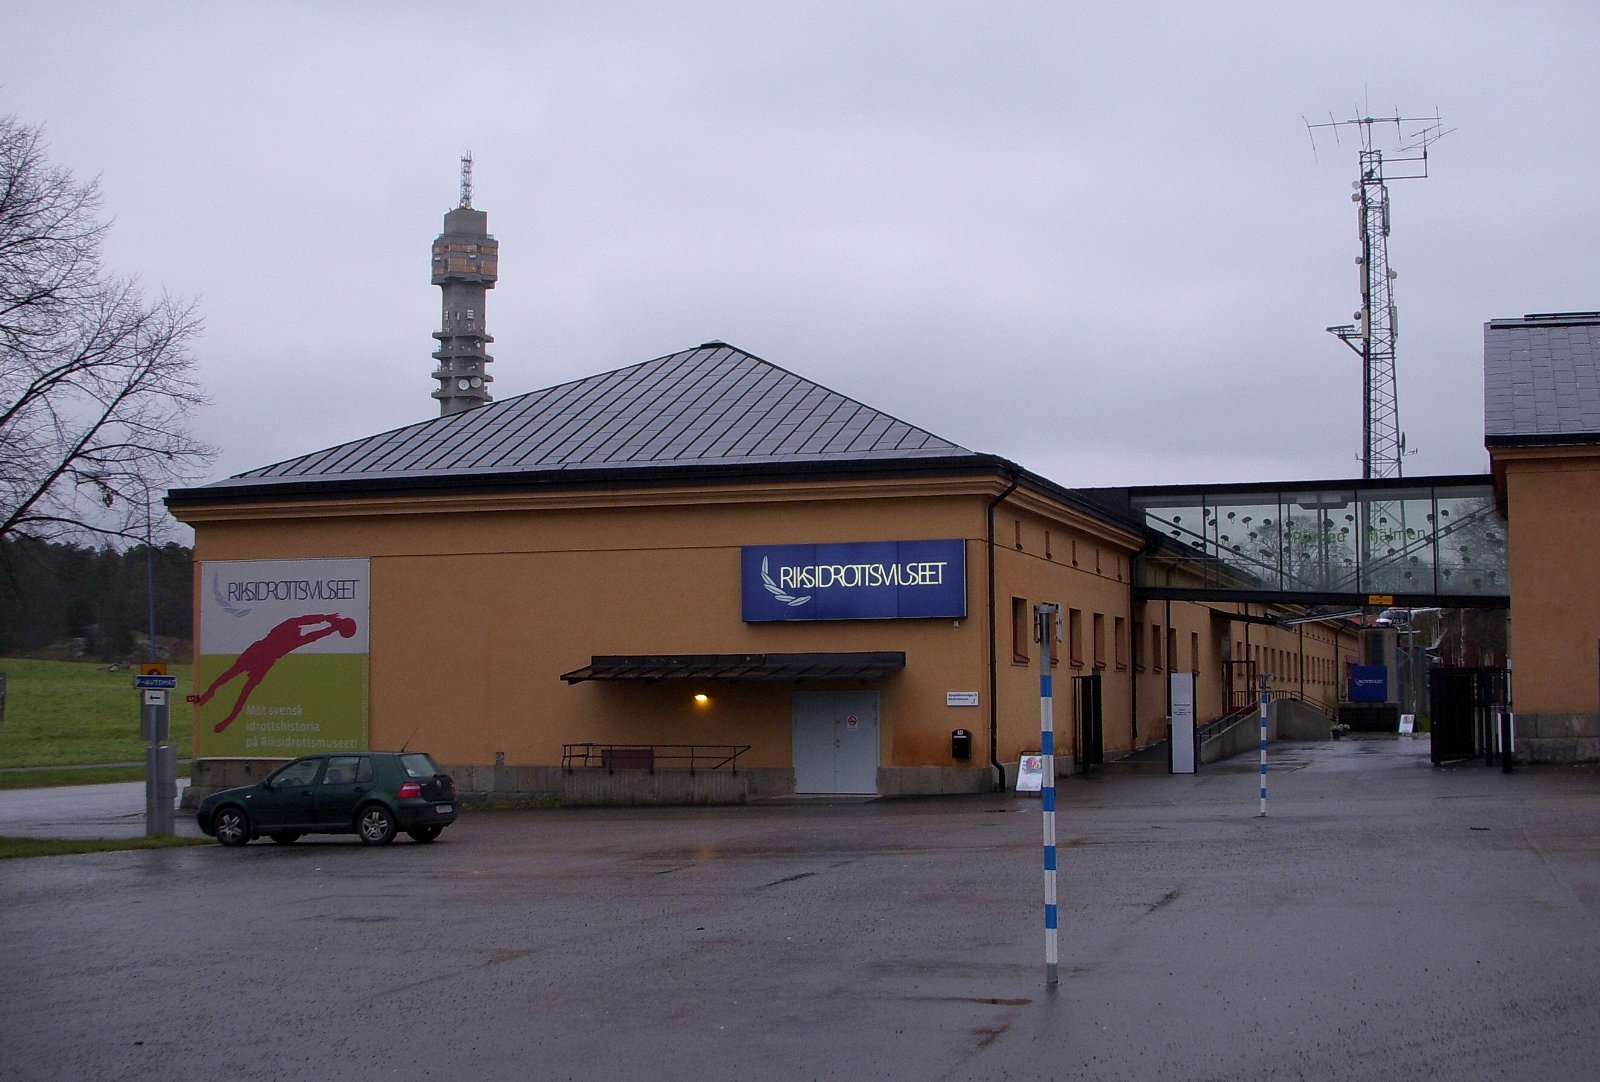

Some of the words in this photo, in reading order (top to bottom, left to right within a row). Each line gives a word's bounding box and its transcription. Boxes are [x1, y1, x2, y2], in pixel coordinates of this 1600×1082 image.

[780, 562, 947, 589] RIKSIDROTTSMUSEET
[227, 579, 359, 601] RIKSIDROTTSMUSEET
[268, 705, 304, 716] svensk
